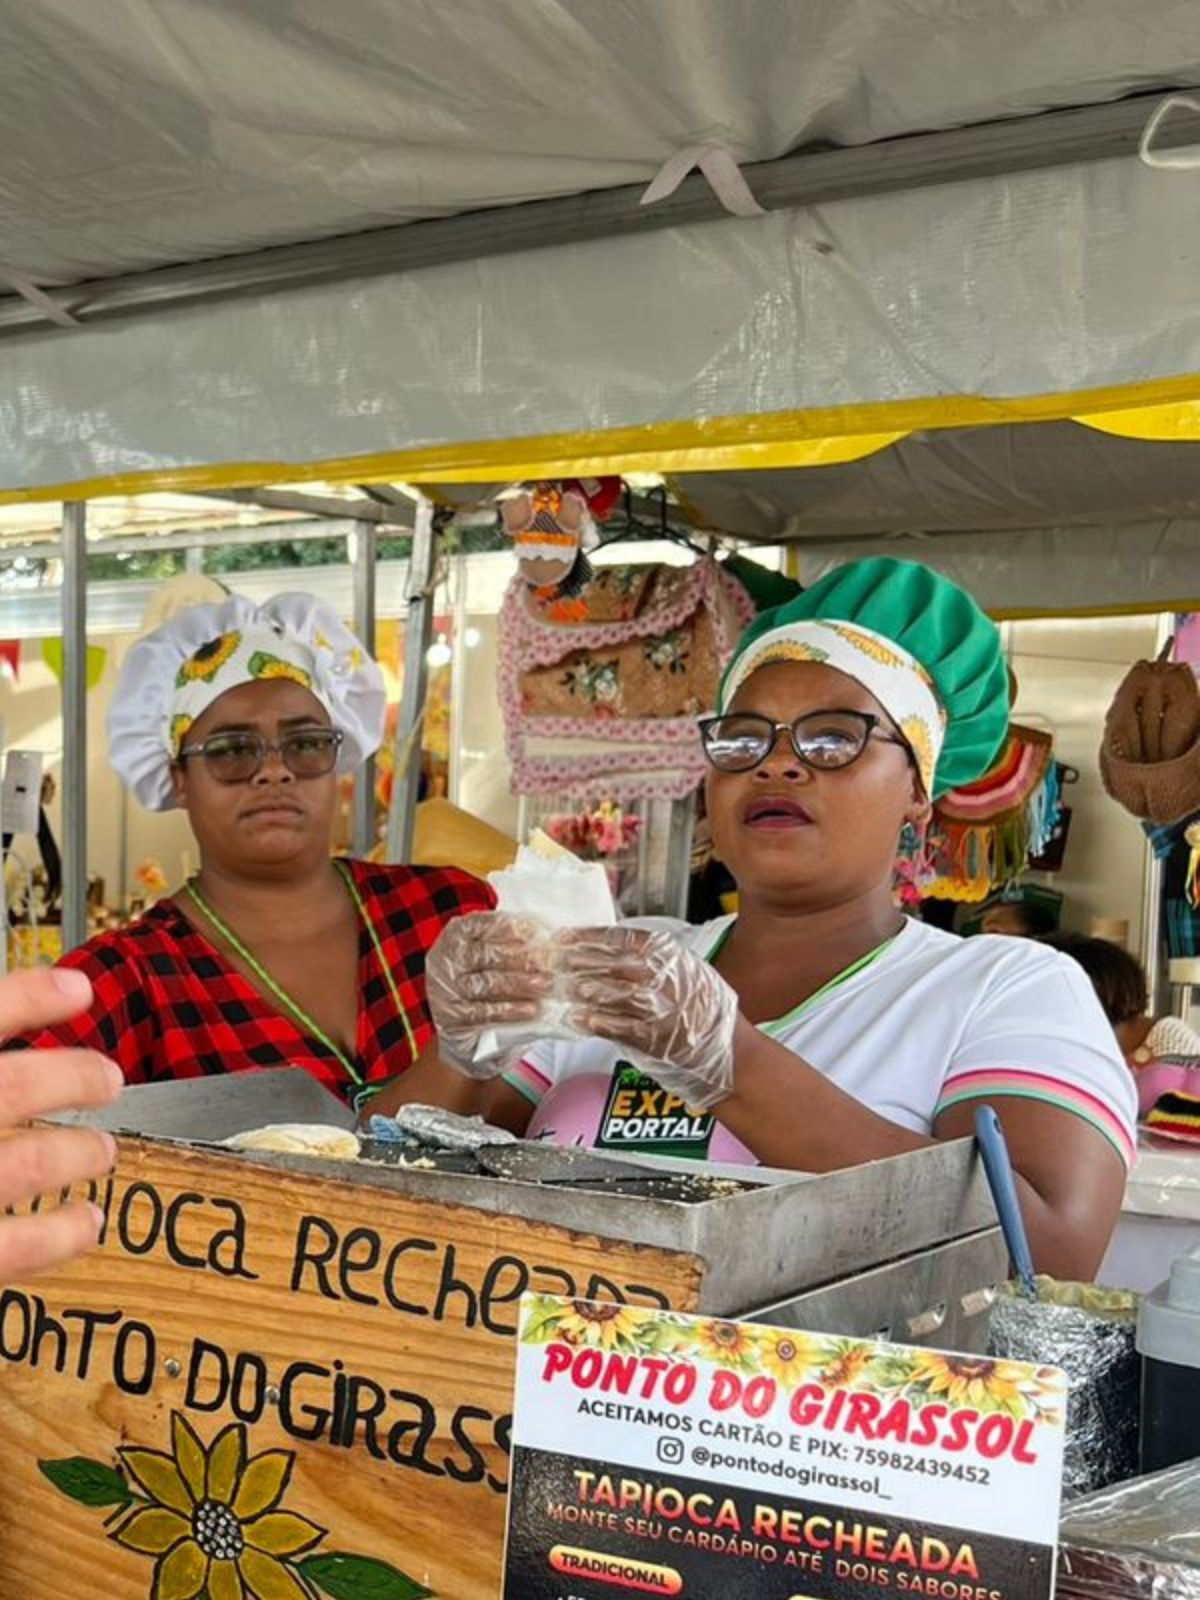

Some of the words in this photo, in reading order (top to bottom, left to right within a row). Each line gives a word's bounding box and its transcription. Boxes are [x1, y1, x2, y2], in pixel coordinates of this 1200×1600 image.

[605, 1117, 705, 1139] PORTAL
[186, 1337, 267, 1424] DO
[541, 1343, 697, 1405] PONTO
[708, 1369, 777, 1418] DO
[789, 1383, 1038, 1465] GIRASSOL
[577, 1398, 693, 1432] ACEITAMOS
[698, 1418, 783, 1449] CARTÃO
[788, 1434, 802, 1452] E
[807, 1437, 848, 1461] PIX:
[853, 1446, 990, 1486] 75982439452
[691, 1446, 893, 1500] @pontodogirassol_
[547, 1502, 619, 1532] MONTE
[624, 1516, 663, 1540] SEU
[668, 1525, 778, 1564] CARDÁPIO
[783, 1550, 823, 1574] ATÉ
[835, 1558, 890, 1586] DOIS
[896, 1570, 1002, 1600] SABORES
[573, 1470, 742, 1533] TAPIOCA
[753, 1503, 980, 1580] RECHEADA
[560, 1552, 669, 1588] TRADICIONAL
